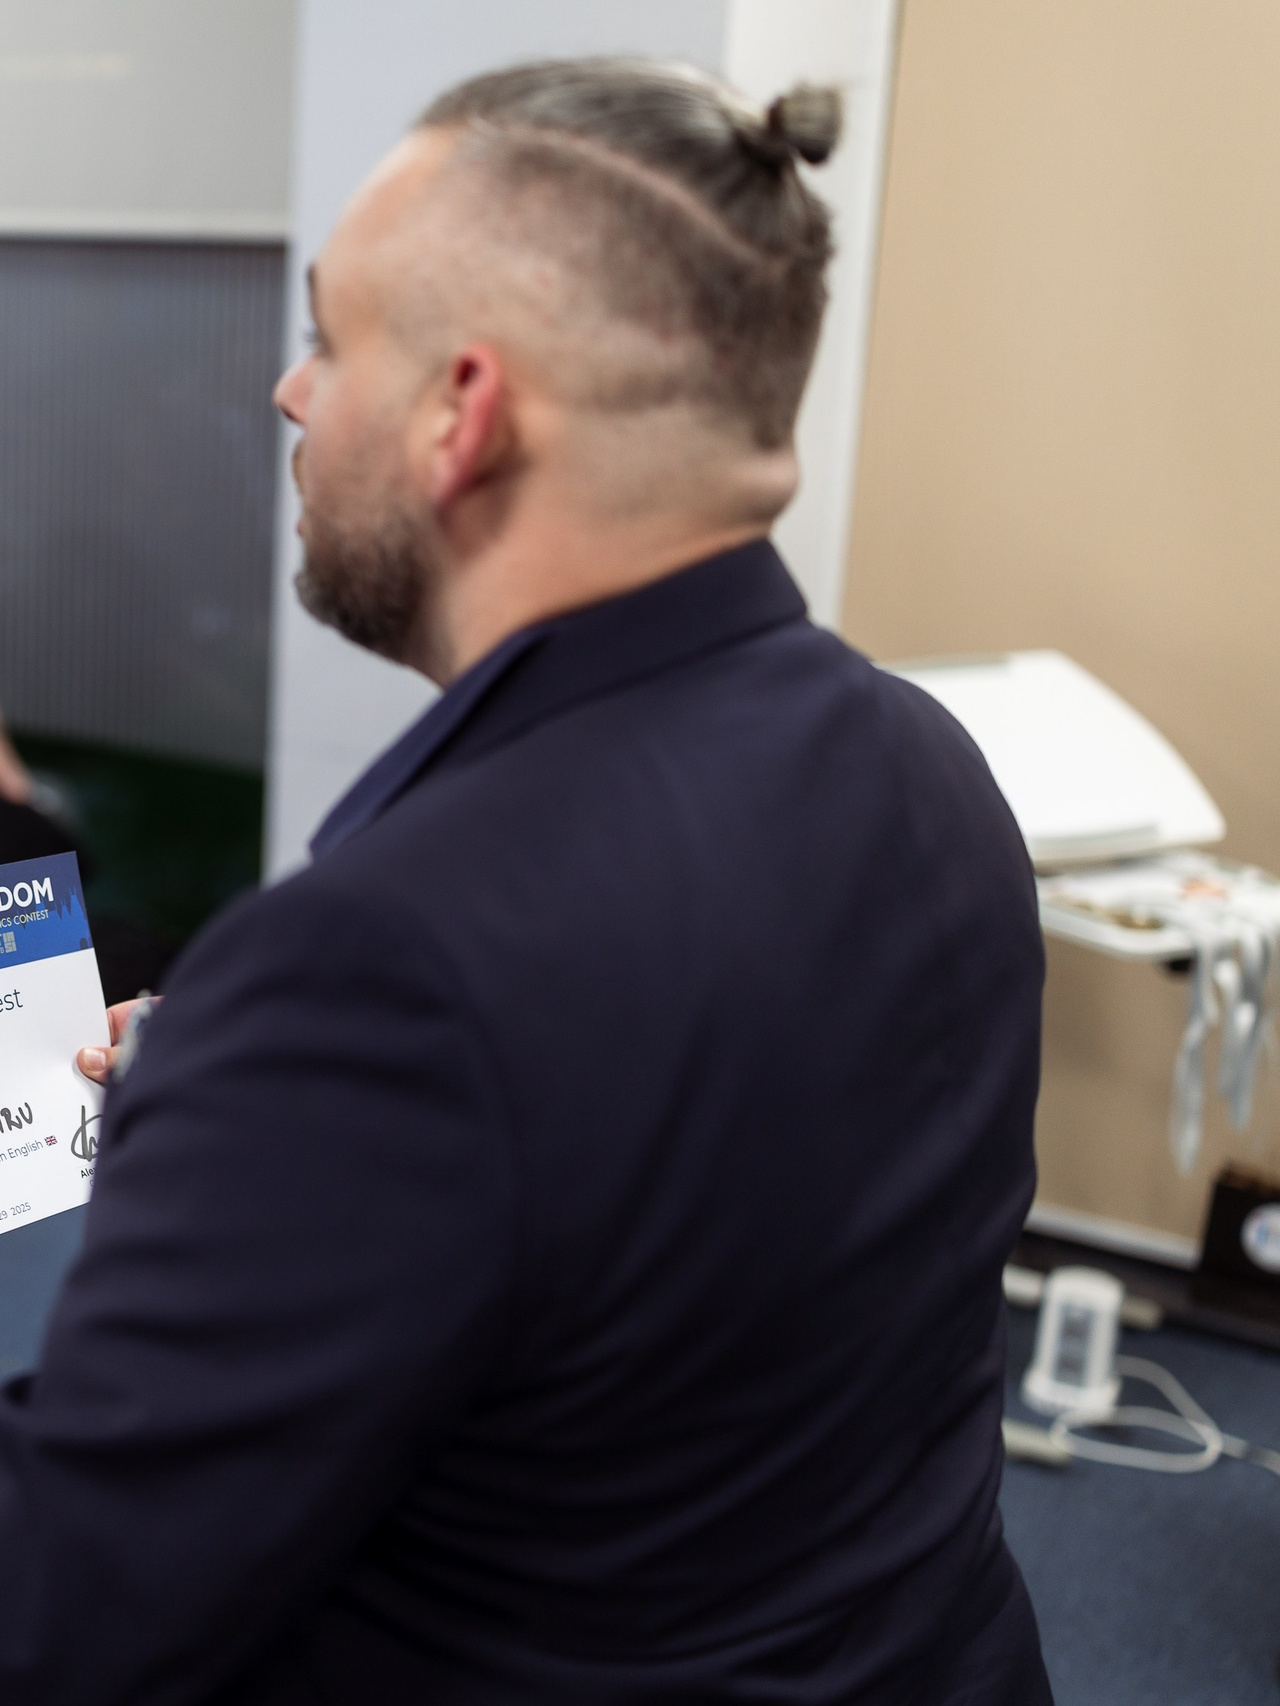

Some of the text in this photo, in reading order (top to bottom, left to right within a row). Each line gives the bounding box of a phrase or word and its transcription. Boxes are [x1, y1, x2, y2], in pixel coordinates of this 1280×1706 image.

[13, 909, 49, 926] CONTEST
[8, 1139, 44, 1159] English
[10, 1201, 32, 1217] 2025
